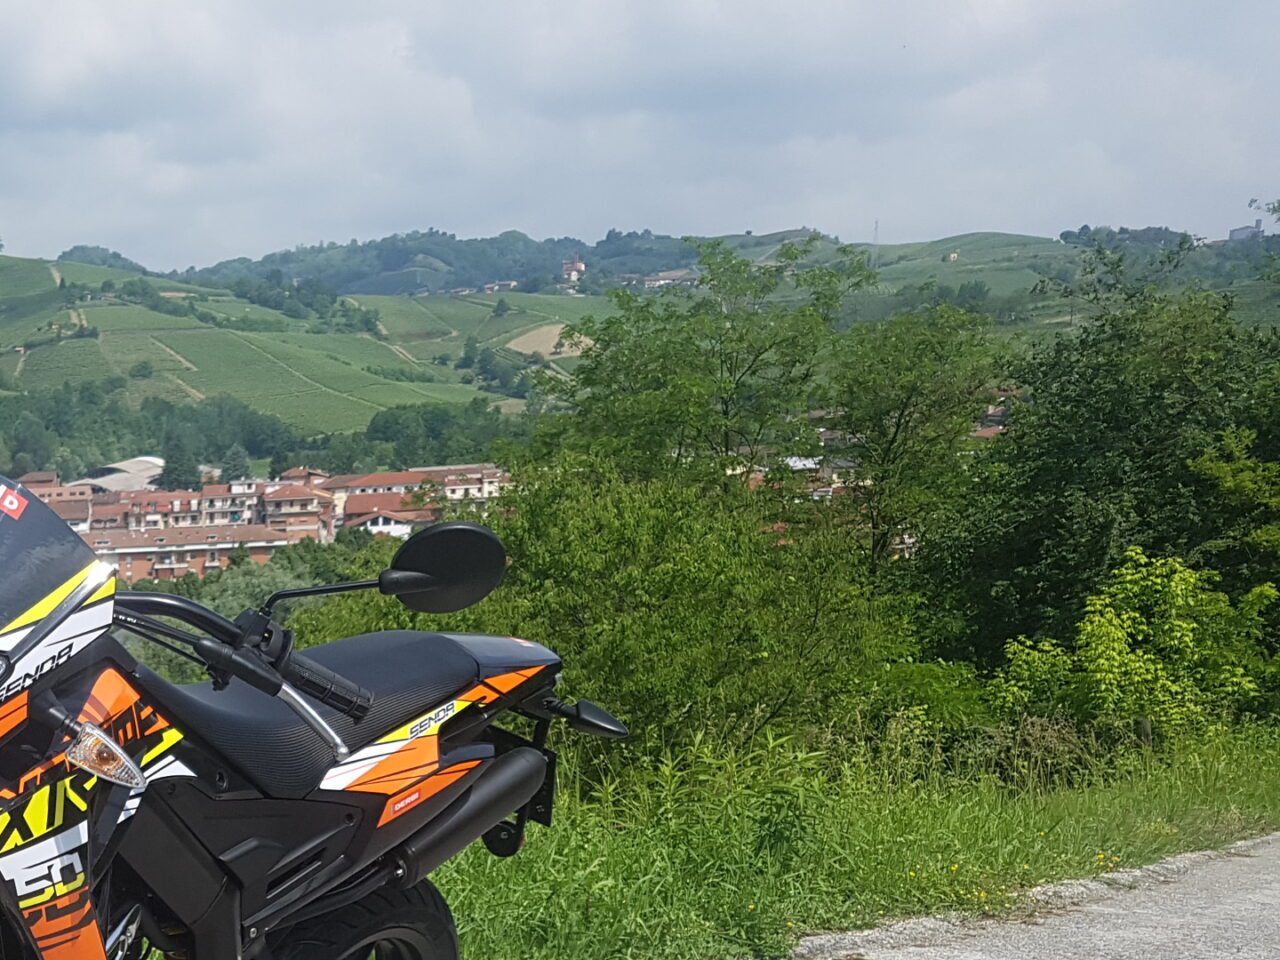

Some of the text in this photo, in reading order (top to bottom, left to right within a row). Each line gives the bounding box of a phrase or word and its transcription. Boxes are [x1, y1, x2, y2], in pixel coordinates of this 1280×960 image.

[3, 494, 19, 510] D
[410, 702, 455, 739] SENDA
[394, 791, 419, 811] DERBI
[13, 850, 87, 910] 50
